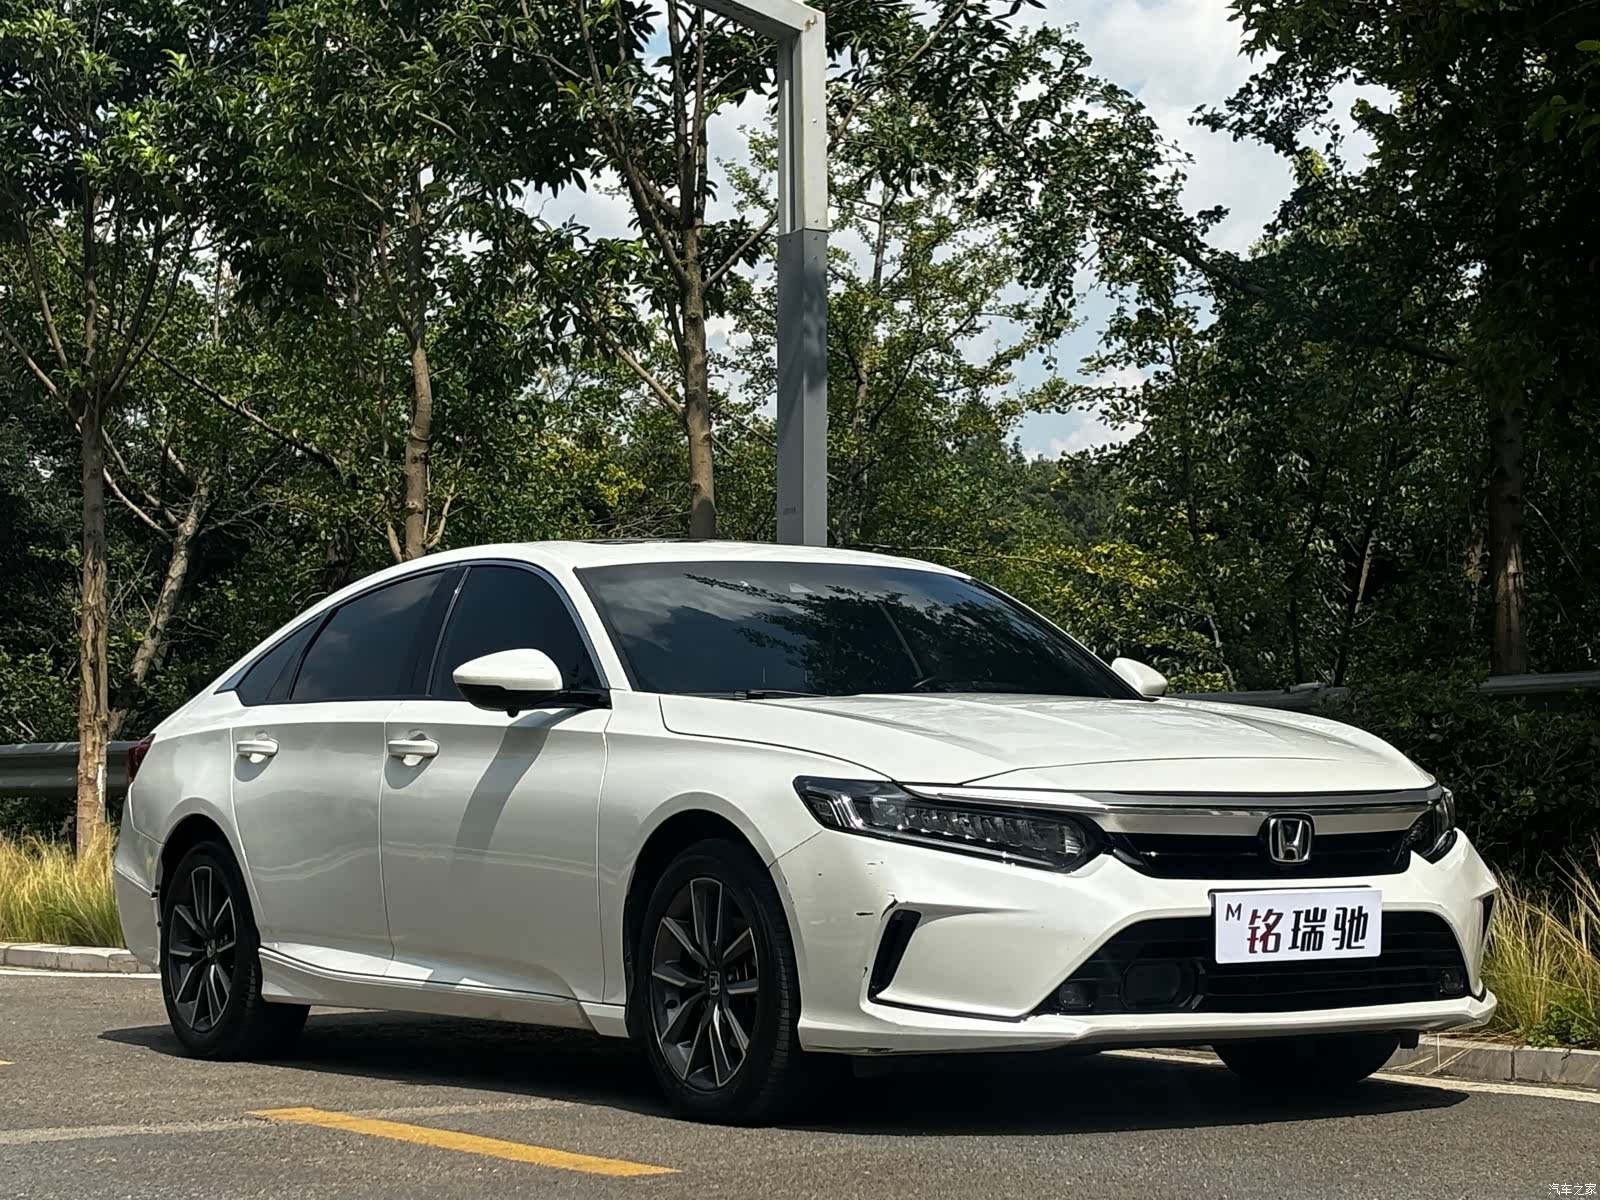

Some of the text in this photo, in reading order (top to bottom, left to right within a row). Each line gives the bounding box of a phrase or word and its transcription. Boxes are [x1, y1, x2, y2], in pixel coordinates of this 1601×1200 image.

[1225, 902, 1242, 921] M
[1247, 905, 1369, 954] 铭瑞驰
